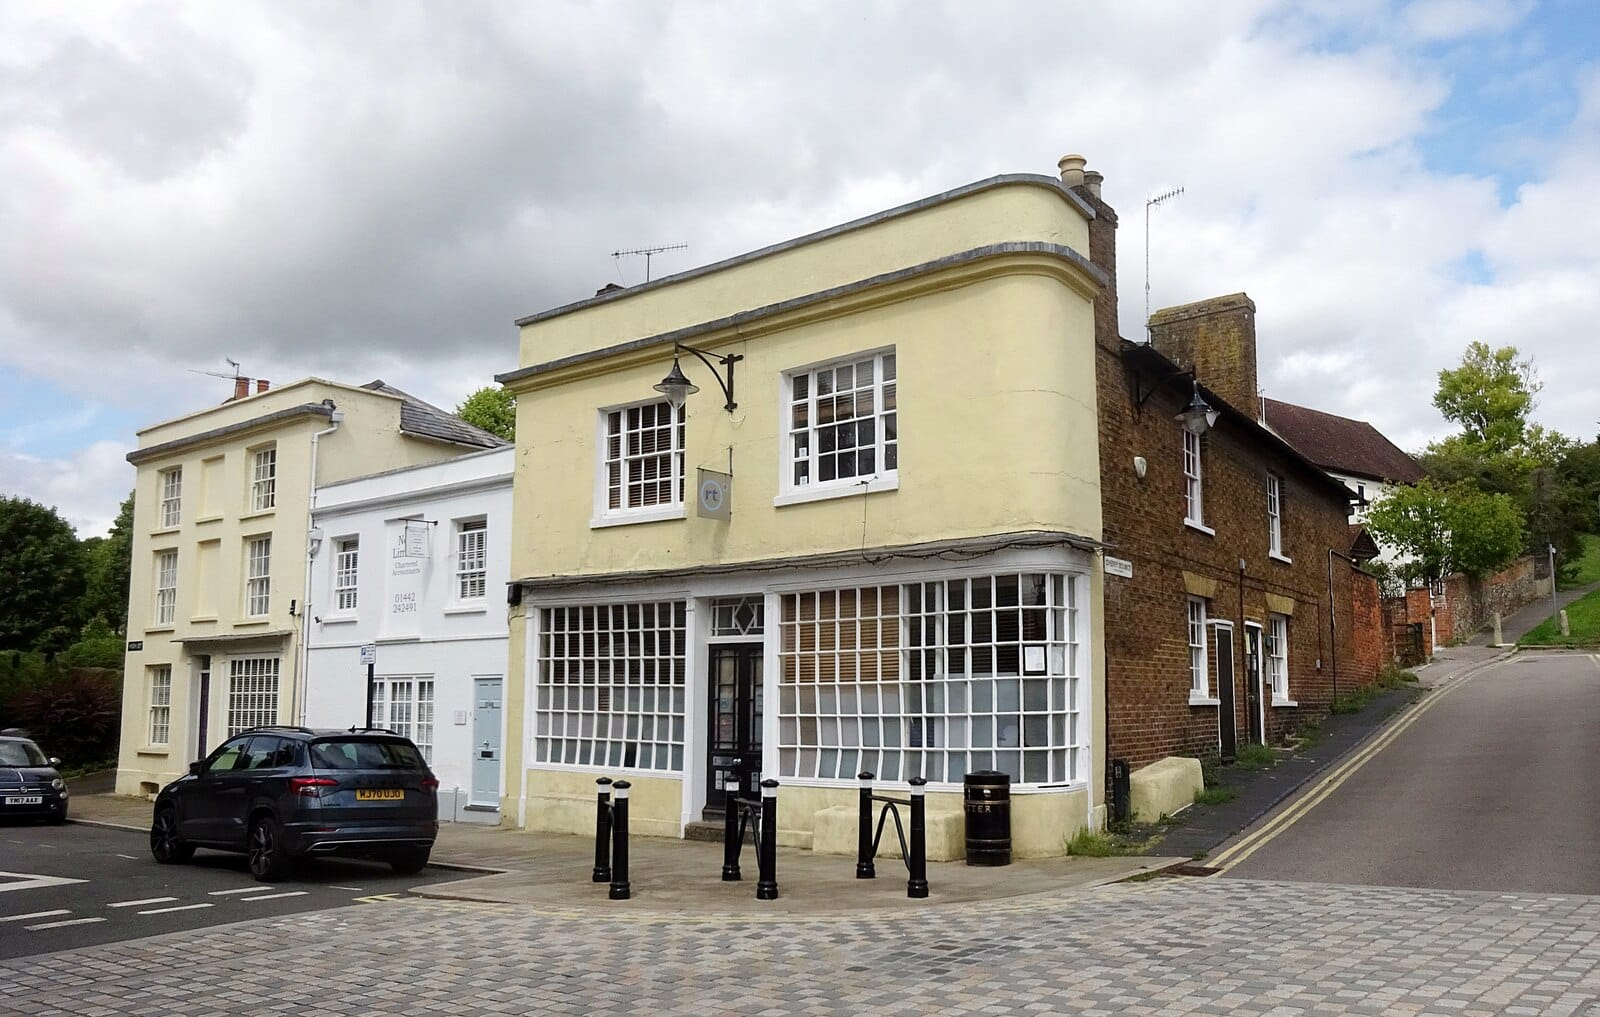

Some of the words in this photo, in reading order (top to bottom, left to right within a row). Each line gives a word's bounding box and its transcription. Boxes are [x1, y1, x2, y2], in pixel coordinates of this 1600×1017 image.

[394, 592, 416, 603] 01442
[392, 602, 417, 614] 242491
[967, 804, 991, 814] TTER
